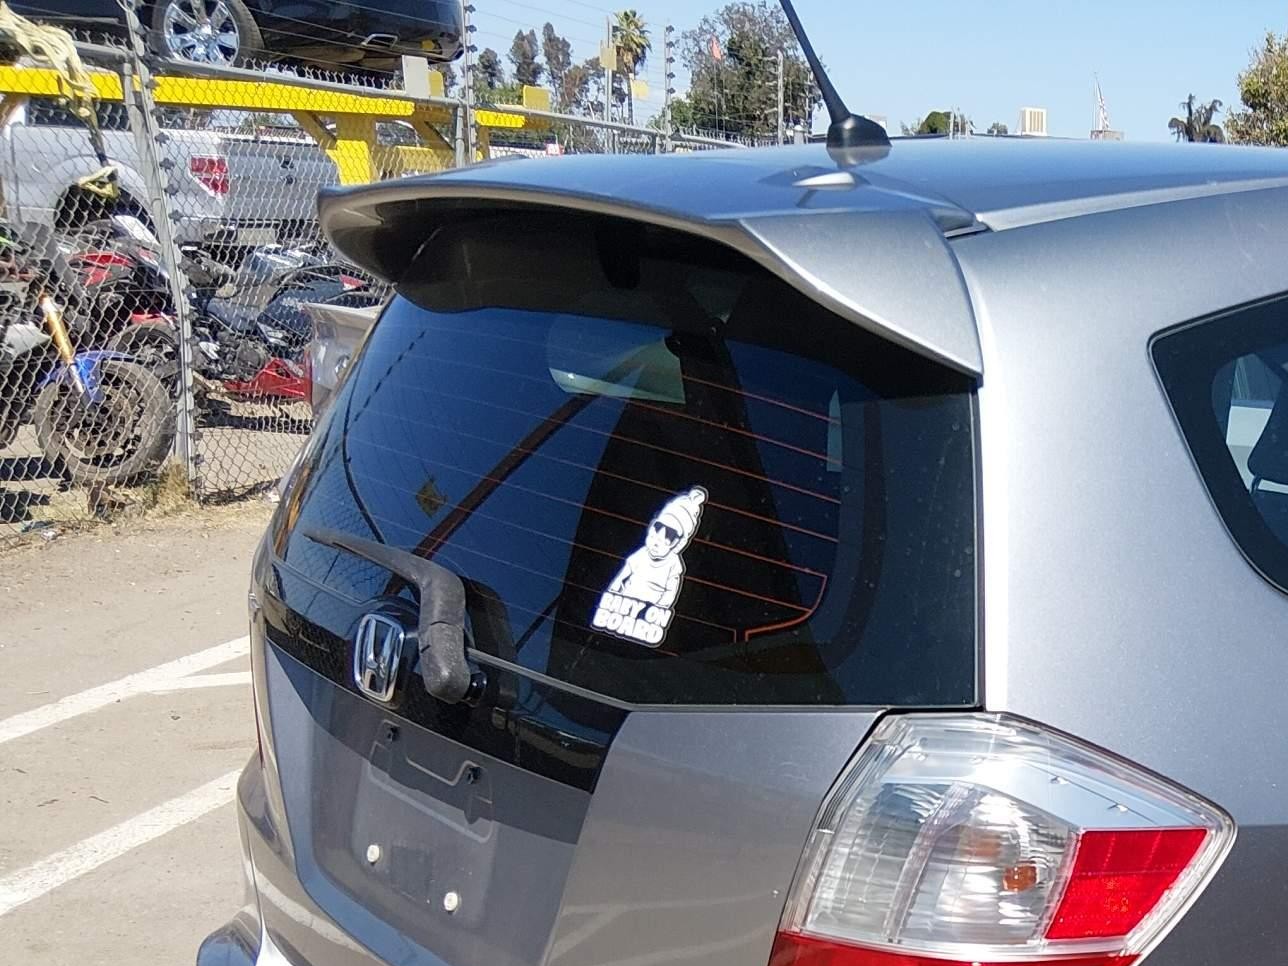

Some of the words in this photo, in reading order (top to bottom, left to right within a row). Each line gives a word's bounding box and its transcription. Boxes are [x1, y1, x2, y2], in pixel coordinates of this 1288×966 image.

[592, 607, 664, 644] BOARD
[599, 591, 647, 619] BABY
[644, 605, 672, 628] ON
